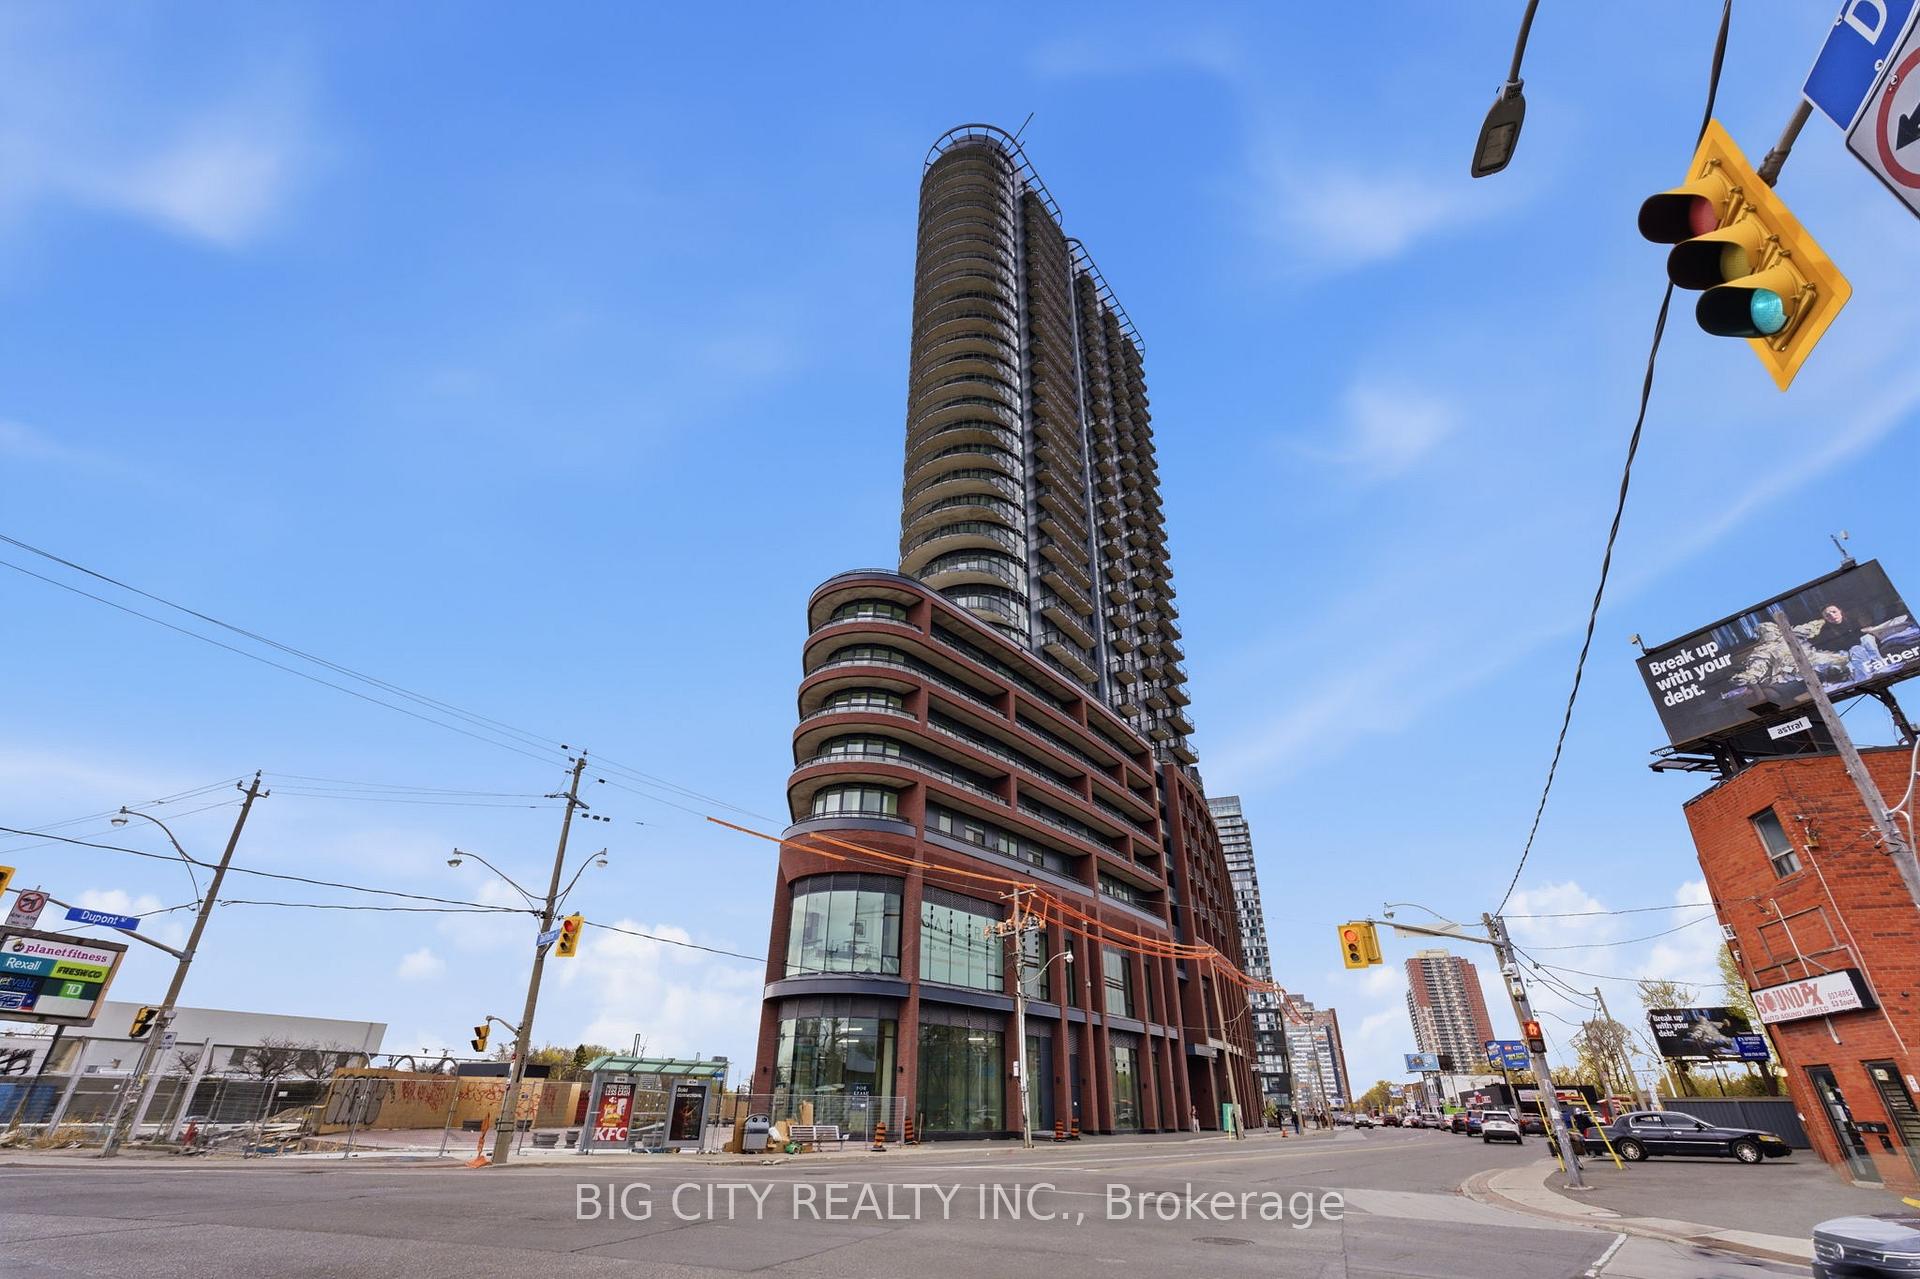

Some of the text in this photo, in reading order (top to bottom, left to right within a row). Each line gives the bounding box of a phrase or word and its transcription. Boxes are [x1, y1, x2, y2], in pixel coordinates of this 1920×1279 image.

[1649, 641, 1718, 676] Break up
[1863, 646, 1919, 672] Farber
[1656, 654, 1732, 691] with your
[1664, 683, 1706, 707] debt.
[1777, 720, 1804, 735] astral
[81, 910, 118, 925] Dupont
[6, 957, 42, 970] Rexall
[66, 983, 82, 995] TD
[1653, 1014, 1684, 1023] Break up
[1780, 1009, 1802, 1019] SOUND
[1803, 1004, 1829, 1016] LIMITED
[1656, 1021, 1689, 1030] with your
[593, 1127, 627, 1140] KFC
